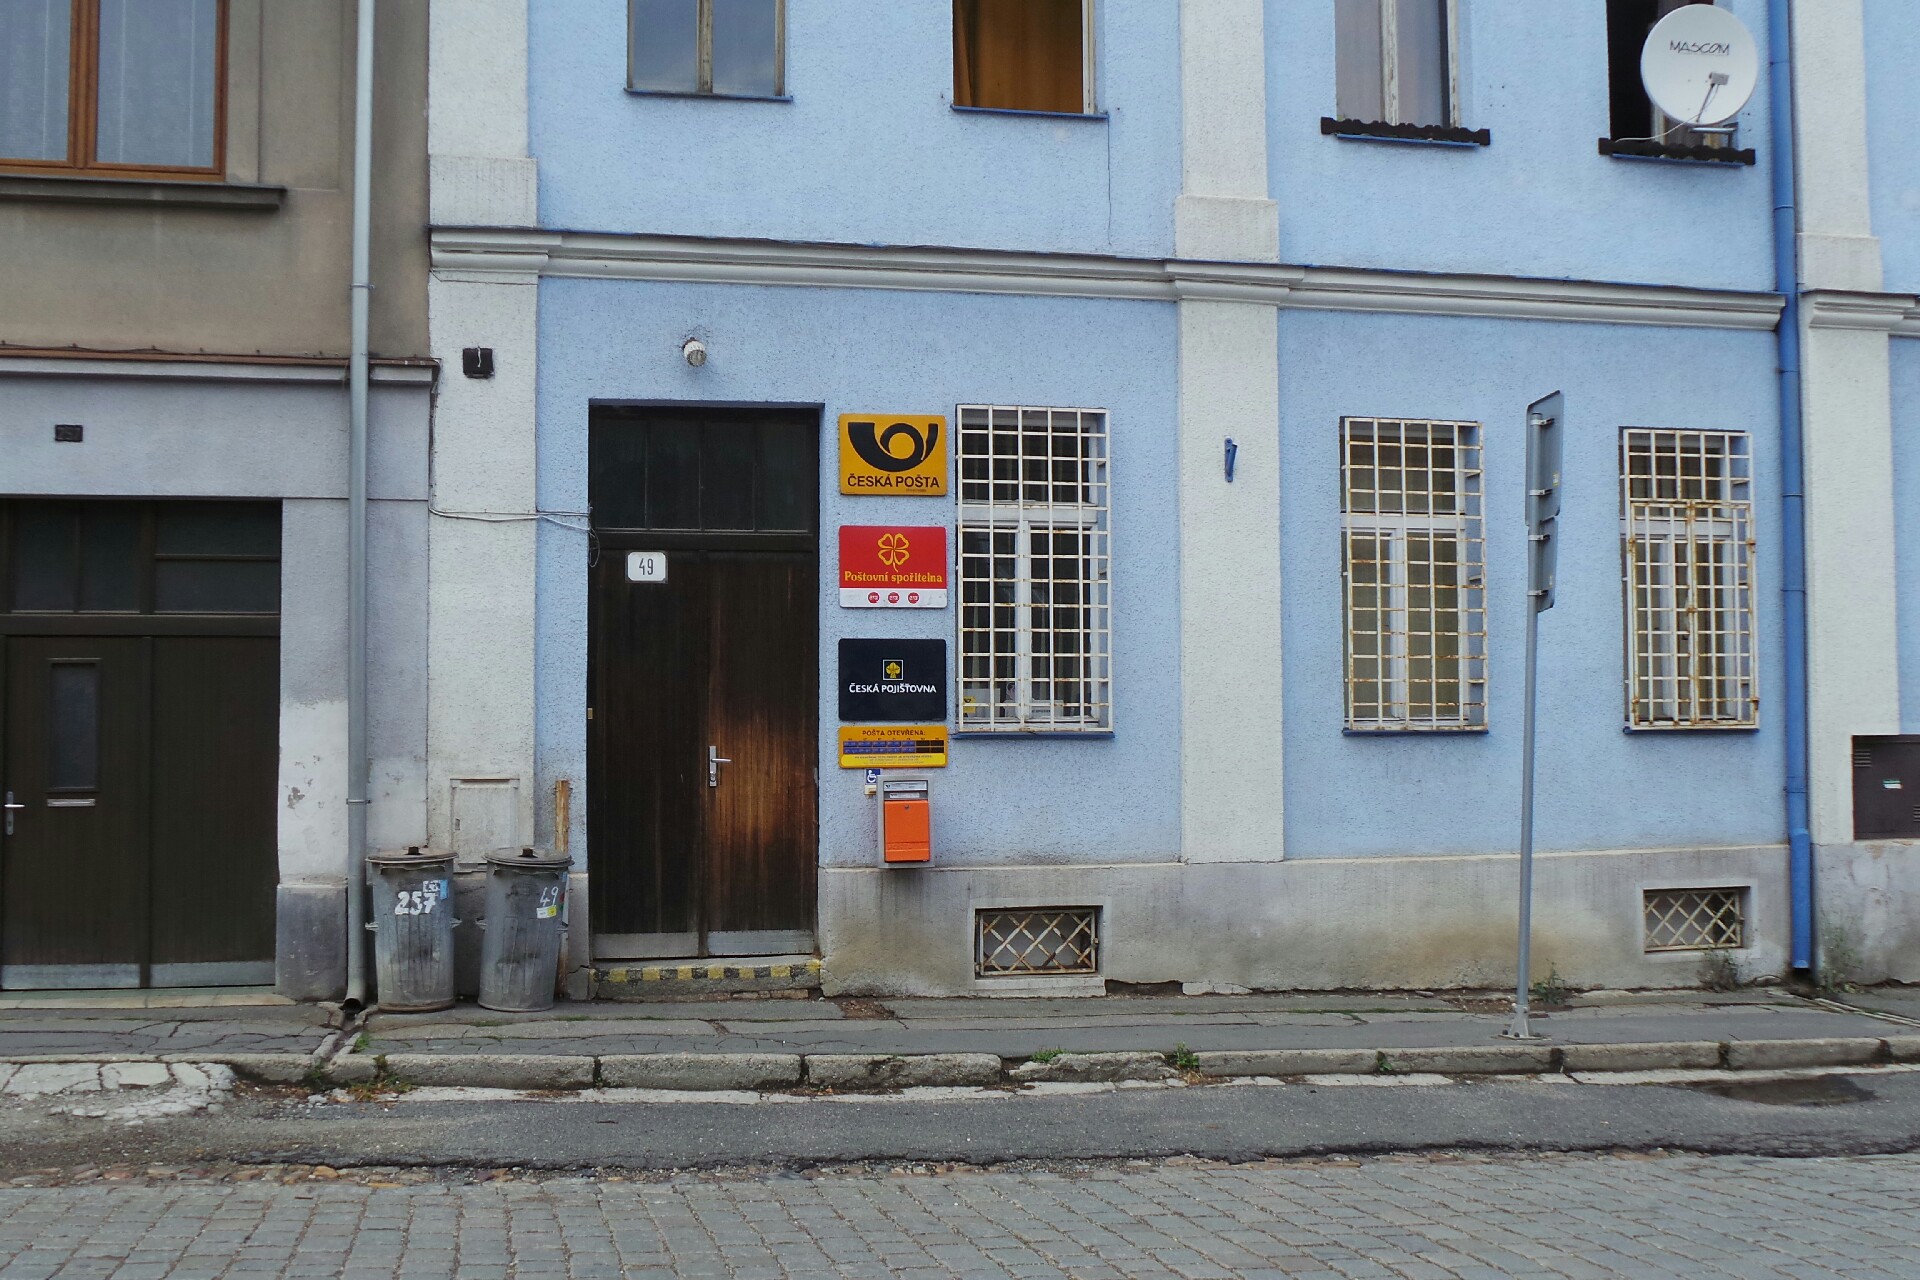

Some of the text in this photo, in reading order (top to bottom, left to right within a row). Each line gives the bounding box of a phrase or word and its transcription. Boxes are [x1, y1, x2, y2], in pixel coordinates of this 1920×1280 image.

[1669, 40, 1730, 56] MASCOM
[848, 473, 939, 488] ČESKÁ POŠTA
[639, 558, 654, 575] 49
[844, 571, 943, 584] Poštovní spořitelna
[849, 682, 937, 693] ČESKÁ POJIŠŤOVNA
[862, 728, 885, 736] POŠTA
[394, 891, 436, 916] 257
[540, 886, 559, 907] 49
